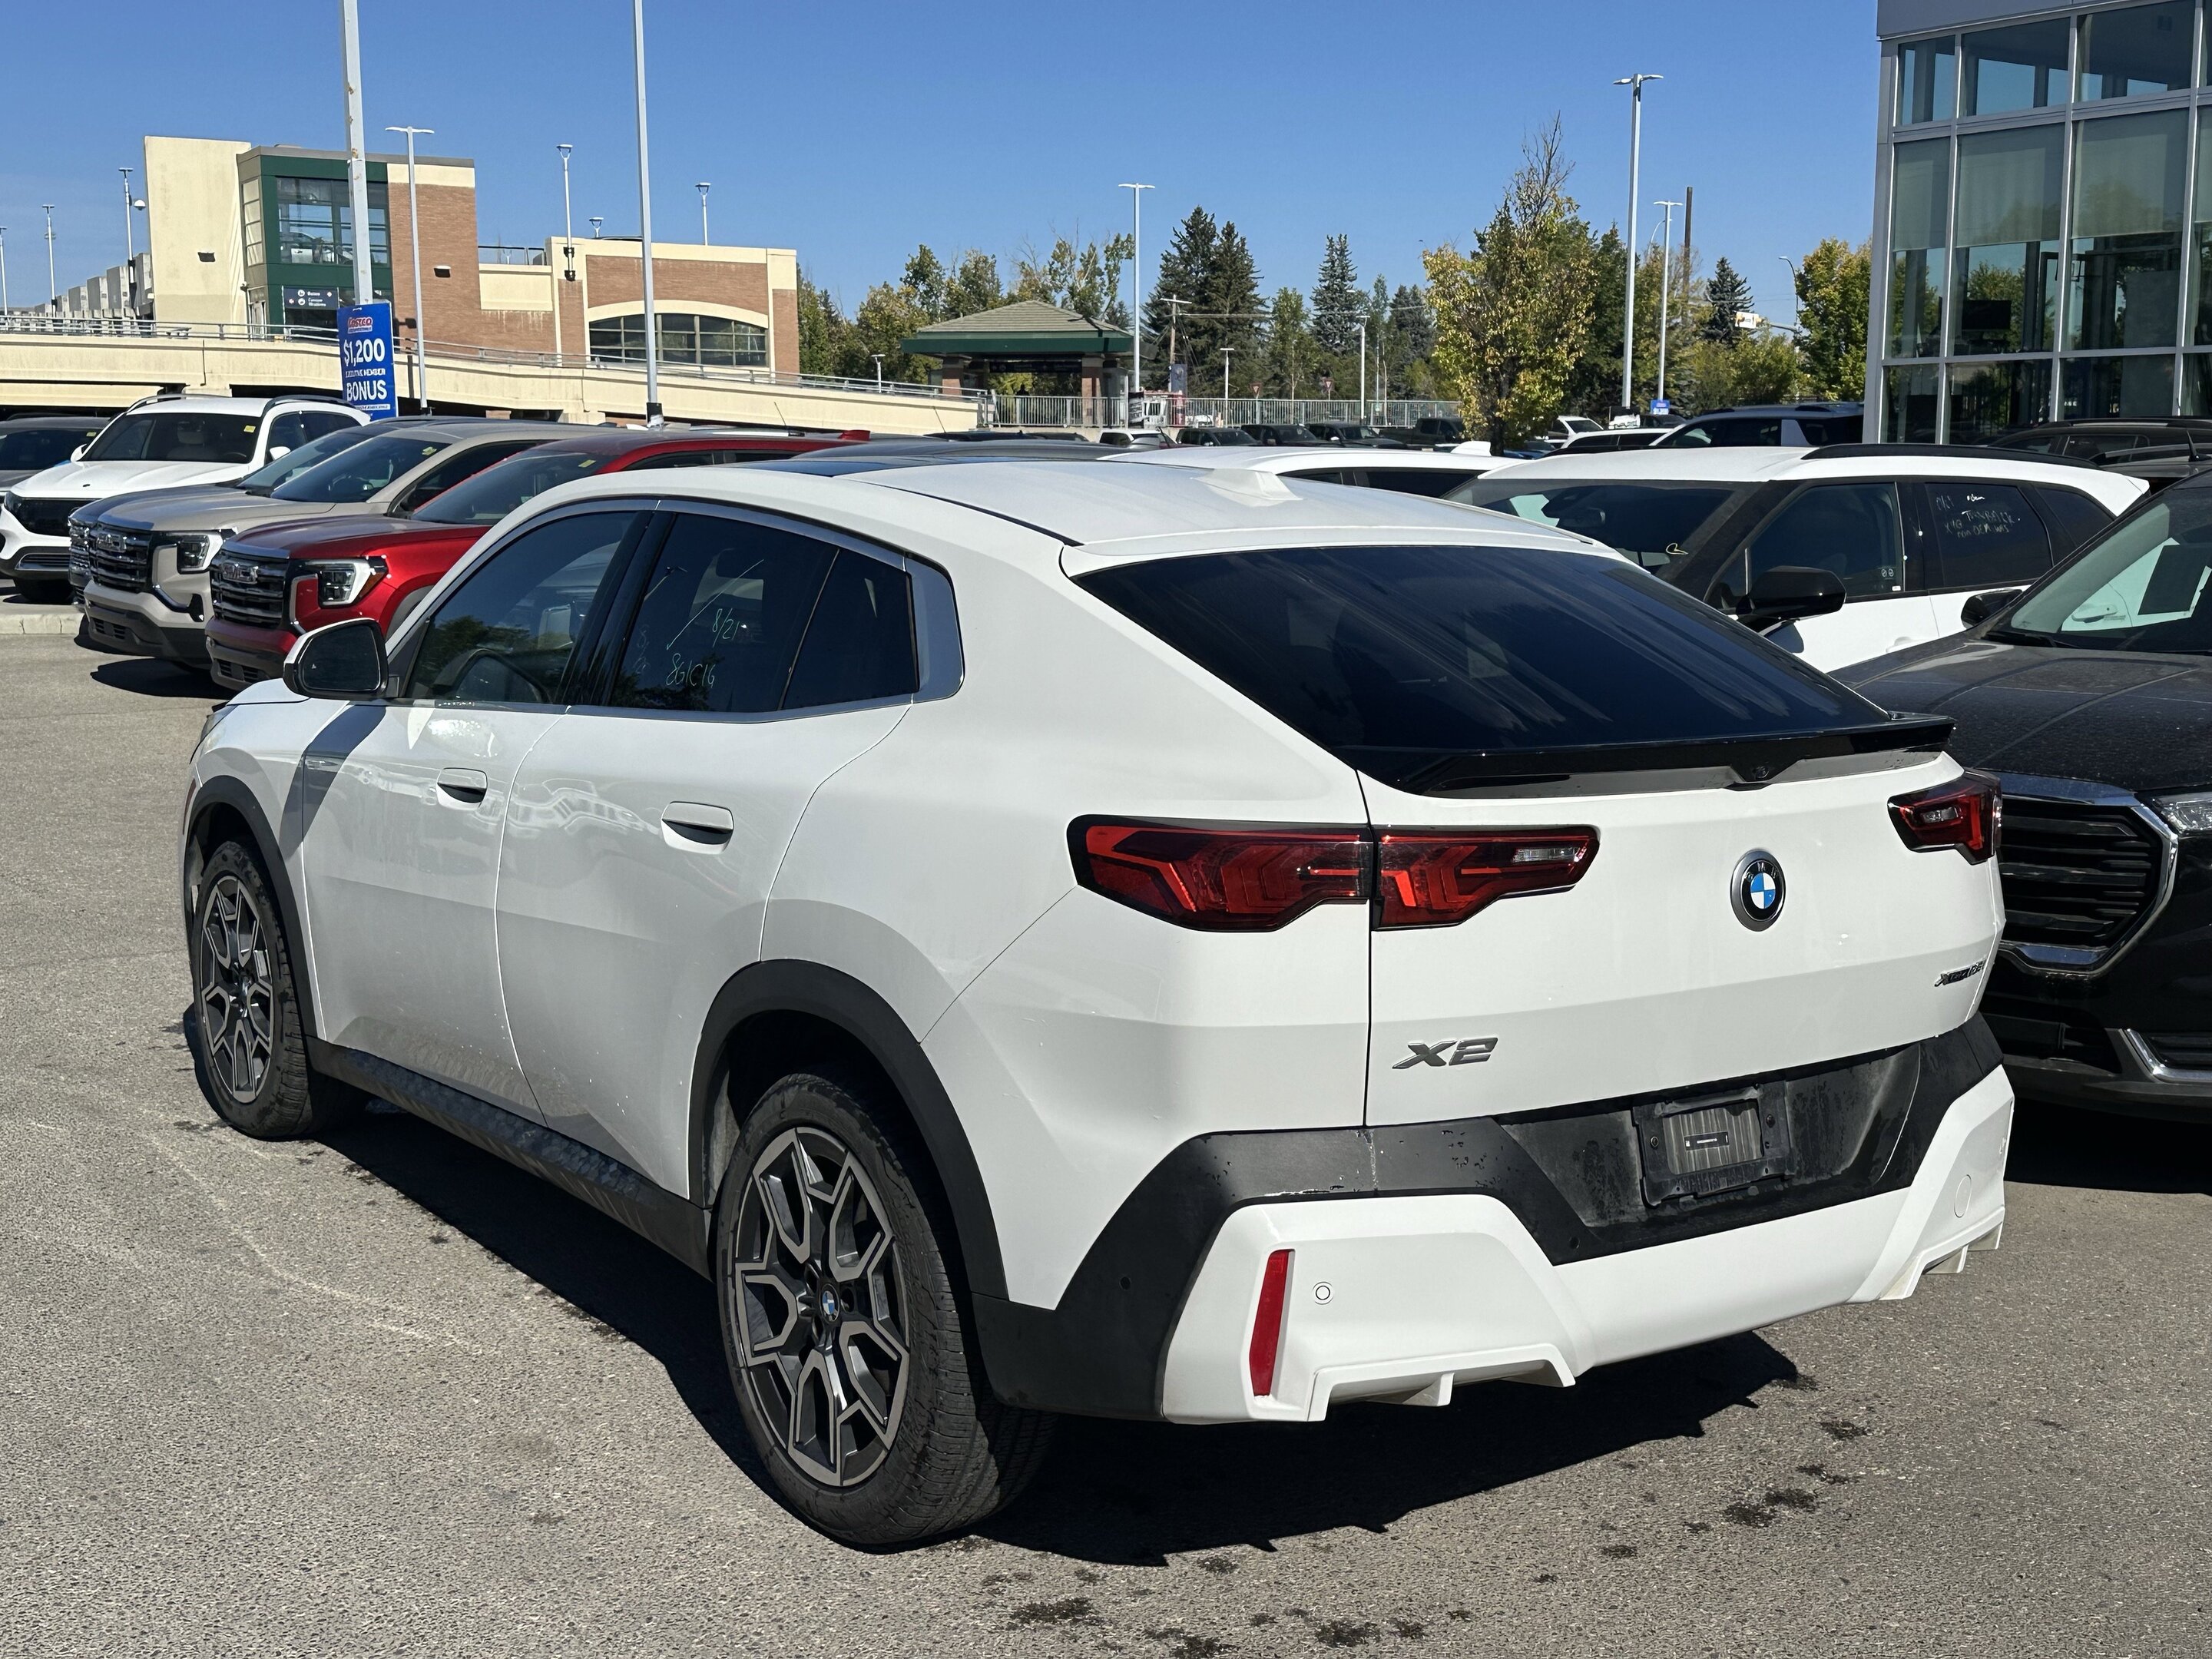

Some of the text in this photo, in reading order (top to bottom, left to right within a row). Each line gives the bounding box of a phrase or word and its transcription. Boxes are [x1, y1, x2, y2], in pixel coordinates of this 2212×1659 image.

[344, 338, 385, 366] $1,200
[346, 379, 387, 401] BONUS
[1392, 1037, 1498, 1069] X2
